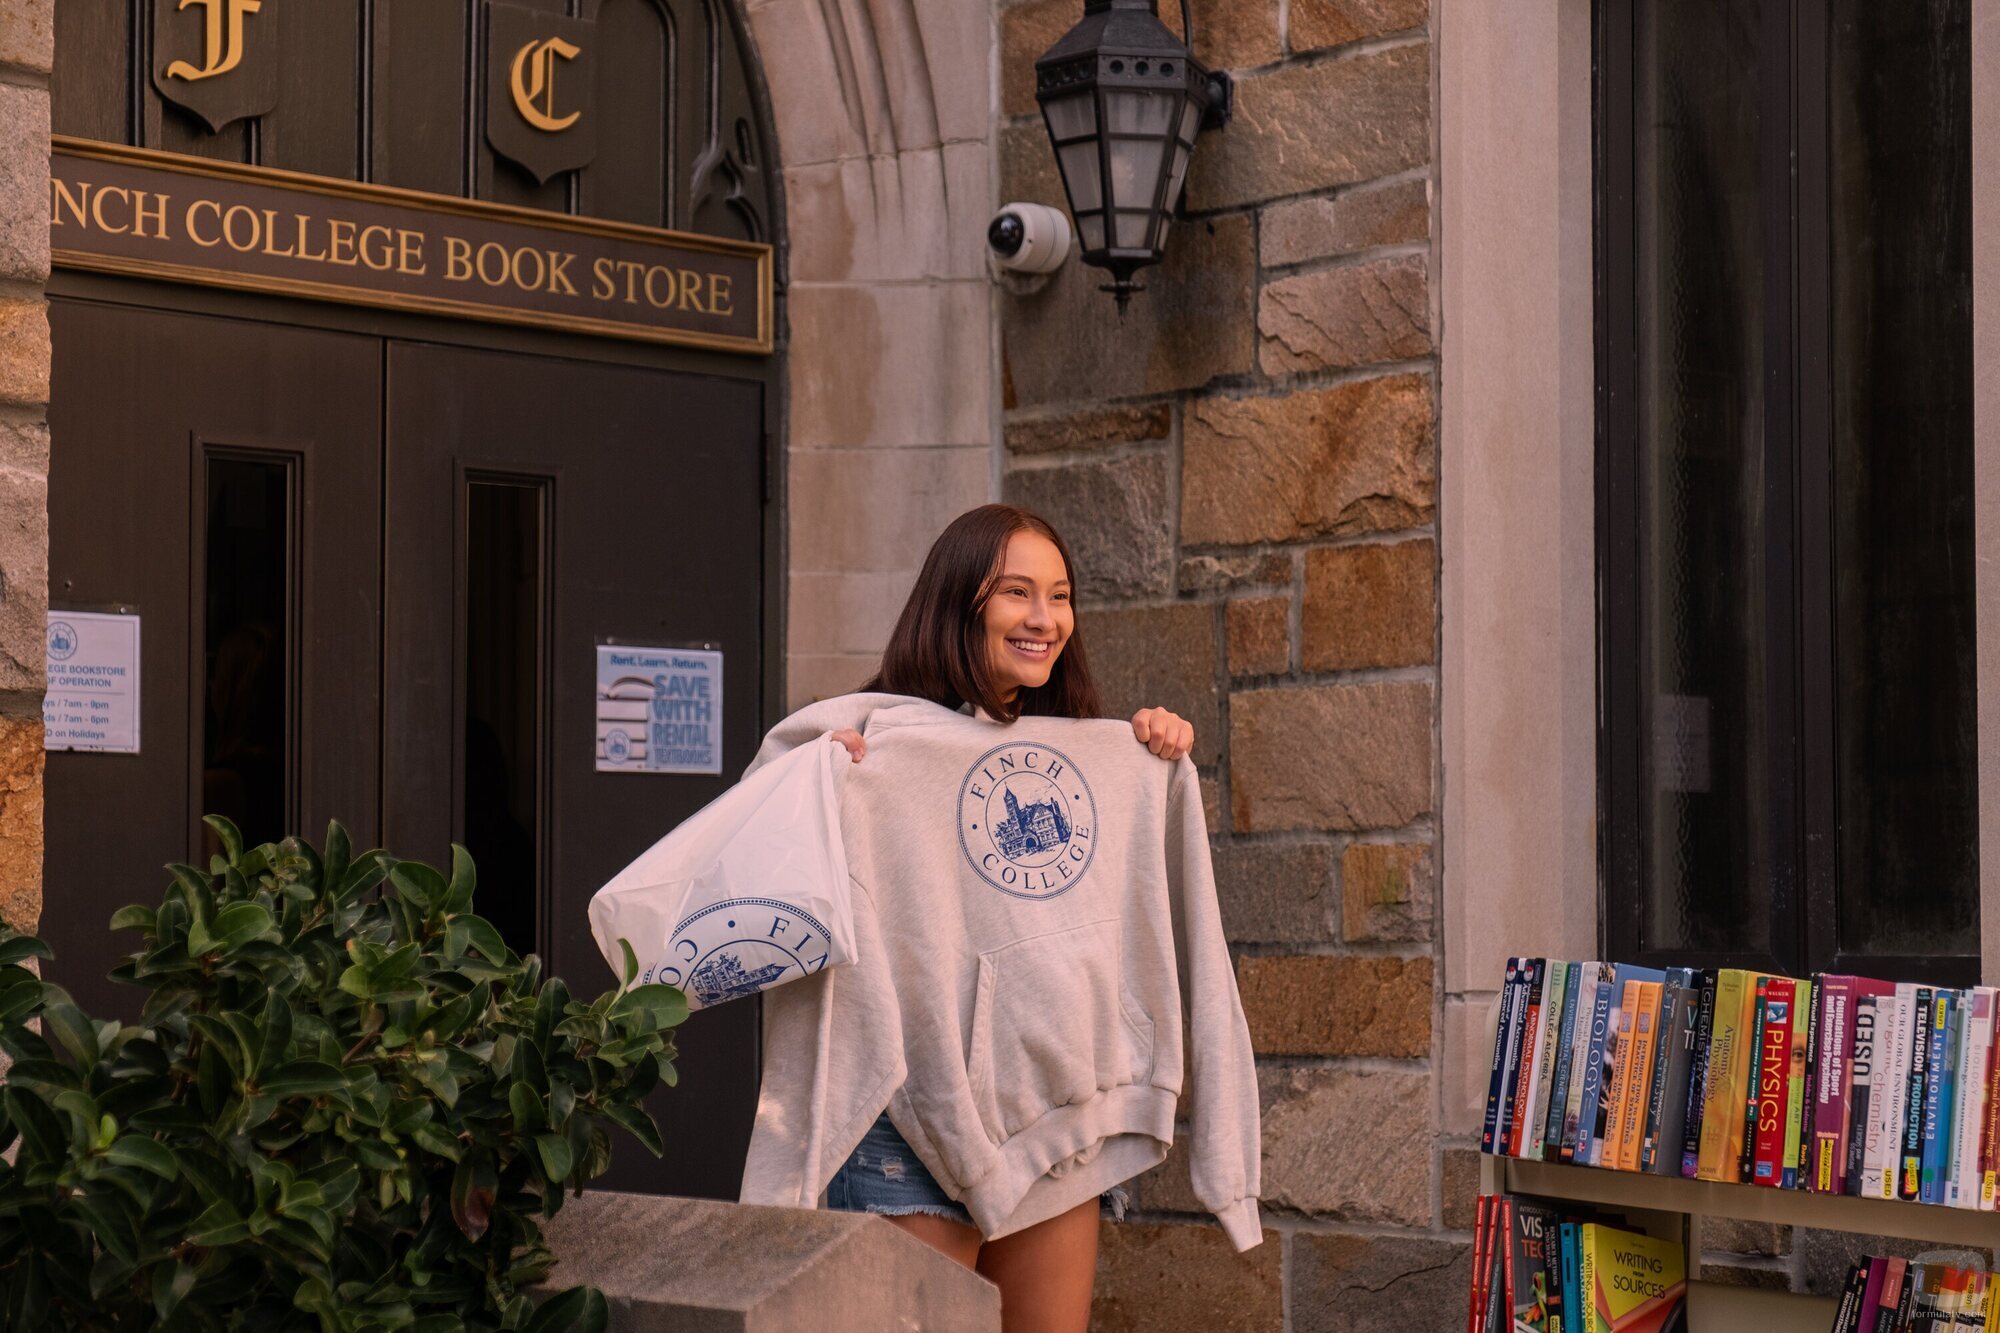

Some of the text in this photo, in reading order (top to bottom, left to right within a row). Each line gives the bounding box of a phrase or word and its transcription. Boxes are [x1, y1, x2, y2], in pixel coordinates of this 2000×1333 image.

[510, 36, 583, 132] C
[185, 200, 428, 277] COLLEGE
[443, 236, 579, 297] BOOK
[591, 258, 735, 317] STORE
[59, 677, 112, 687] OPERATION
[69, 665, 126, 676] BOOKSTORE
[610, 655, 636, 666] Rent.
[671, 658, 707, 670] Return.
[654, 674, 710, 698] SAVE
[64, 700, 82, 708] 7am
[64, 714, 82, 723] 7am
[653, 699, 711, 721] WITH
[68, 729, 105, 739] Holidays
[653, 723, 712, 747] RENTAL
[970, 752, 1063, 800] FINCH
[982, 825, 1089, 890] COLLEGE
[1492, 983, 1511, 1071] Advanced Accounting
[1510, 983, 1529, 1071] Advanced Accounting
[1562, 998, 1576, 1061] ENVIRONMENTAL
[1823, 1013, 1834, 1051] Exercise
[1826, 995, 1835, 1013] and
[1833, 995, 1846, 1056] Foundations
[1518, 1010, 1537, 1119] ABNORMAL PSYCHOLOGY
[1541, 1001, 1557, 1081] COLLEGE ALGEBRA
[1576, 1007, 1592, 1087] Physical Examination
[1584, 998, 1608, 1098] BIOLOGY
[1695, 991, 1711, 1082] CHEMISTRY
[1718, 1024, 1734, 1079] Anatomy
[1807, 1022, 1816, 1063] Experience
[1833, 1058, 1841, 1068] of
[1853, 1013, 1875, 1076] USED
[1896, 1029, 1905, 1068] GLOBAL
[1914, 1006, 1927, 1072] TELEVISION
[1558, 1064, 1567, 1096] SCIENCE
[1606, 1039, 1624, 1142] PRACTICE OF STATISTICS
[1616, 1039, 1629, 1102] INTRODUCTION
[1624, 1039, 1642, 1144] PRACTICE OF STATISTICS
[1635, 1040, 1647, 1104] INTRODUCTION
[1706, 1038, 1723, 1103] Physiology
[1759, 1029, 1784, 1132] PHYSICS
[1819, 1052, 1831, 1104] Psychology
[1831, 1069, 1841, 1096] Sport
[1926, 1033, 1943, 1140] ENVIRONMENT
[1971, 1044, 1980, 1095] BIOLOGY
[1866, 1072, 1886, 1154] chemistry
[1889, 1072, 1902, 1152] ENVIRONMENT
[1908, 1075, 1922, 1149] PRODUCTION
[1985, 1069, 2000, 1158] Physical Anthropology
[1884, 1170, 1892, 1196] USED
[1585, 1253, 1594, 1290] WRITING
[1613, 1249, 1663, 1273] WRITING
[1613, 1274, 1666, 1299] SOURCES
[1966, 1283, 1974, 1304] USED
